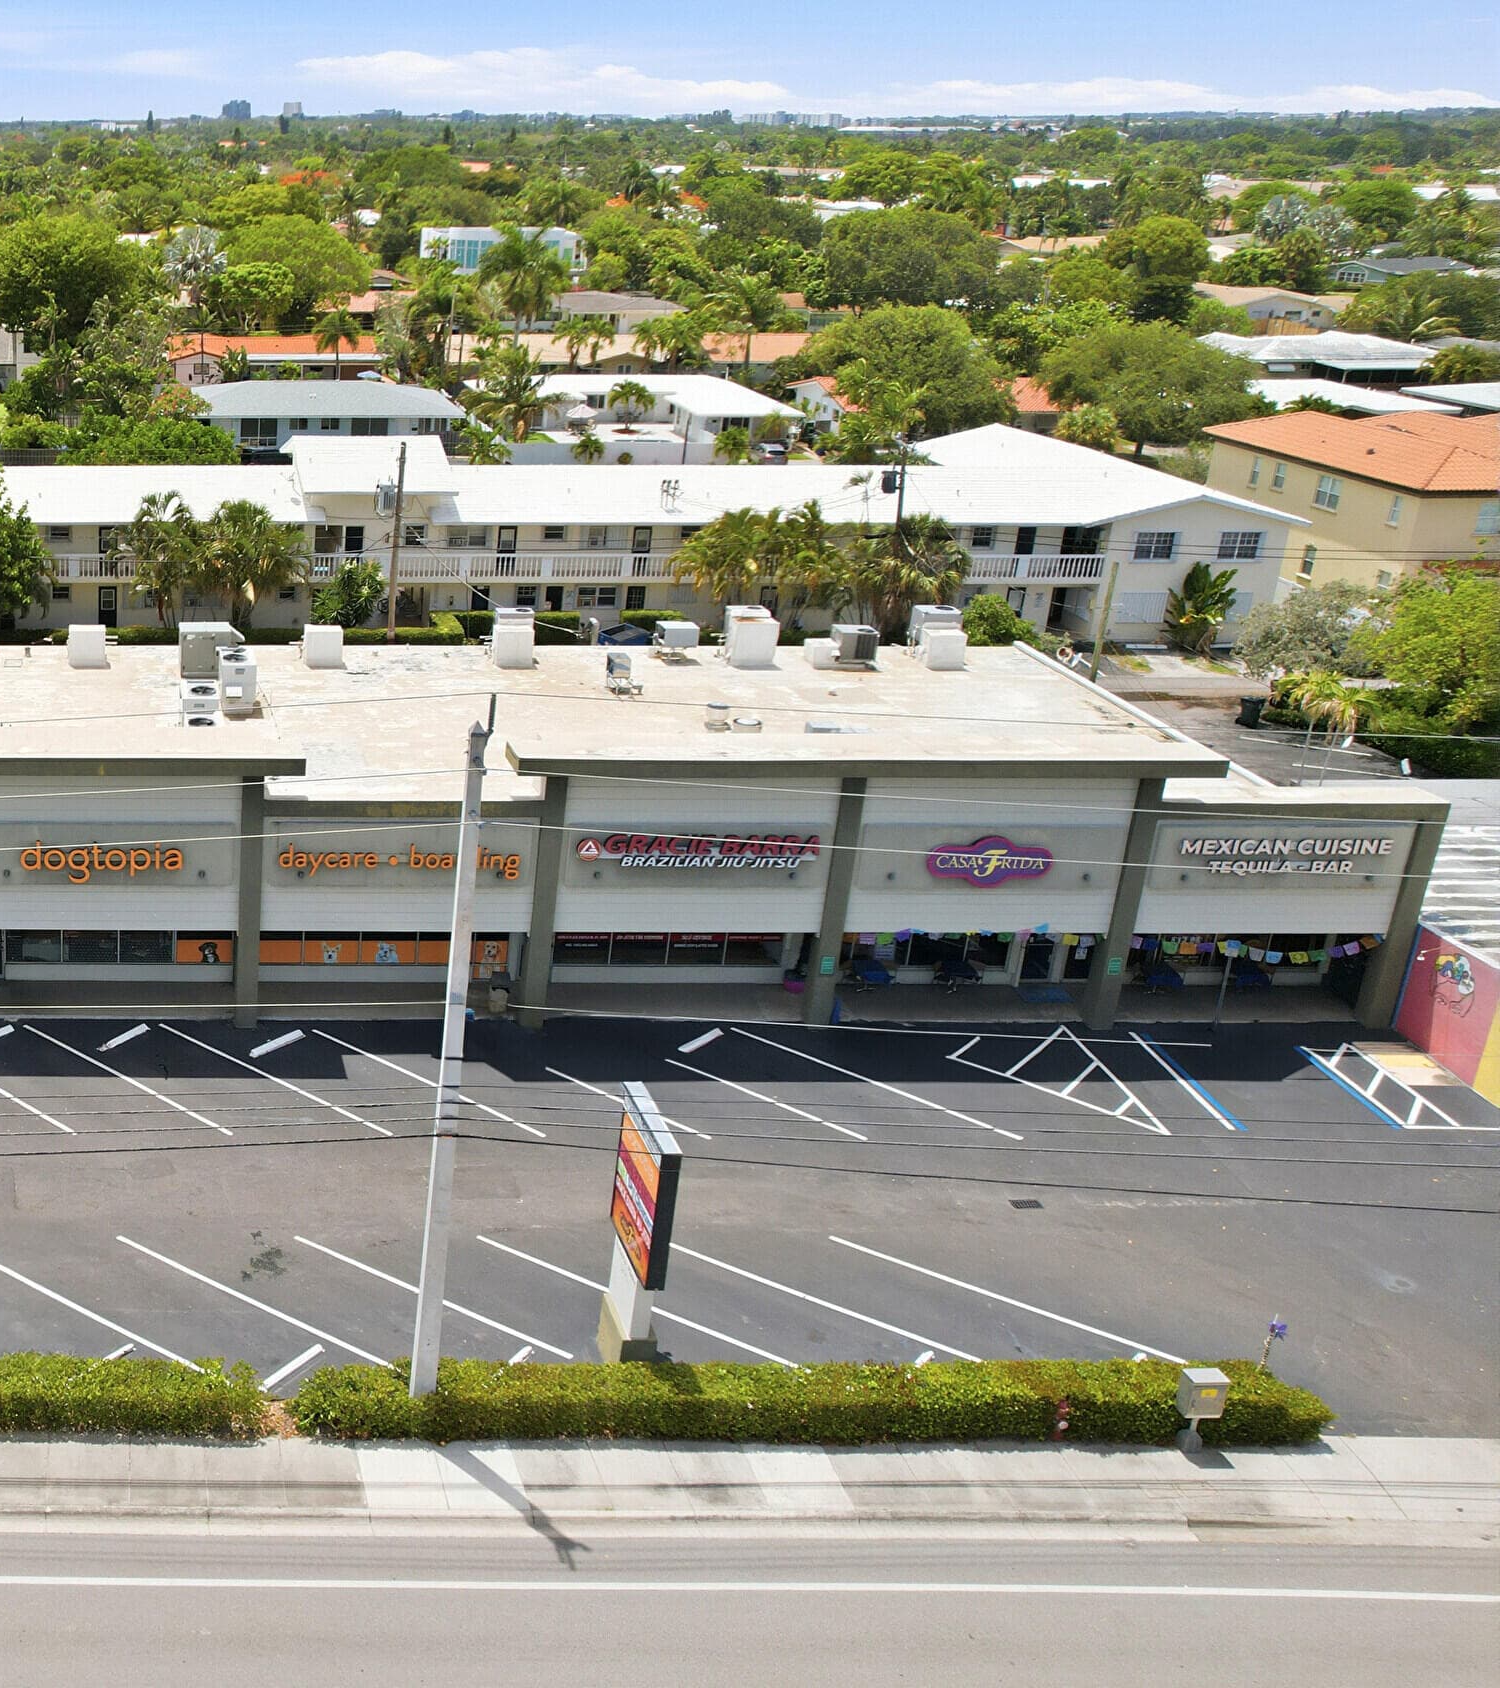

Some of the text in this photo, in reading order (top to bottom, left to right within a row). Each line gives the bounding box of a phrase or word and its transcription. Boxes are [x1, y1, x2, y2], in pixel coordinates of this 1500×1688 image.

[603, 834, 821, 856] GRACIE BARRA
[1181, 838, 1394, 855] MEXICAN CUISINE
[19, 839, 183, 884] dogtopia
[278, 843, 521, 880] daycare boaing
[620, 856, 801, 869] BRAZILIAN JIU-JITSU
[936, 849, 1045, 877] CASA FRIDA
[1209, 861, 1293, 876] TEQUILA
[1311, 861, 1353, 873] BAR
